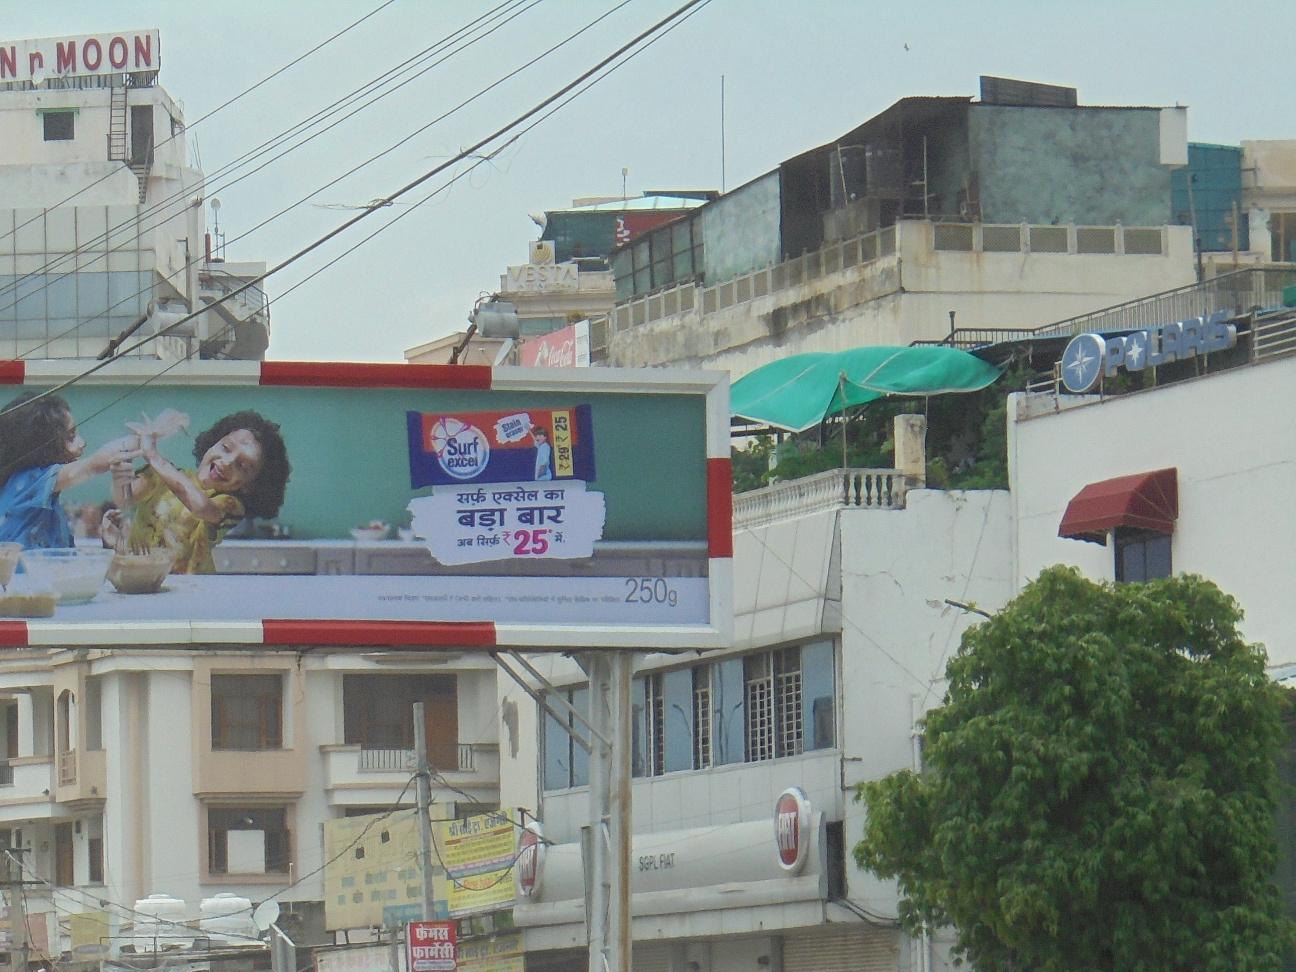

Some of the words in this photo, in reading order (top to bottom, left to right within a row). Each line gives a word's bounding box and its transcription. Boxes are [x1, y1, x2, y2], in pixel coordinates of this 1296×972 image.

[56, 34, 152, 75] MOON
[508, 265, 577, 282] VESTA
[1105, 309, 1238, 377] POLARIS
[501, 418, 522, 433] Stain
[447, 436, 479, 456] Surf
[447, 456, 479, 468] excel
[492, 486, 539, 505] एक्सेल
[543, 489, 565, 500] का
[457, 508, 508, 531] बड़ा
[516, 506, 565, 525] बार
[457, 537, 474, 547] अब
[624, 577, 678, 607] 250g
[779, 811, 797, 850] FIAT
[415, 924, 450, 941] फेमस
